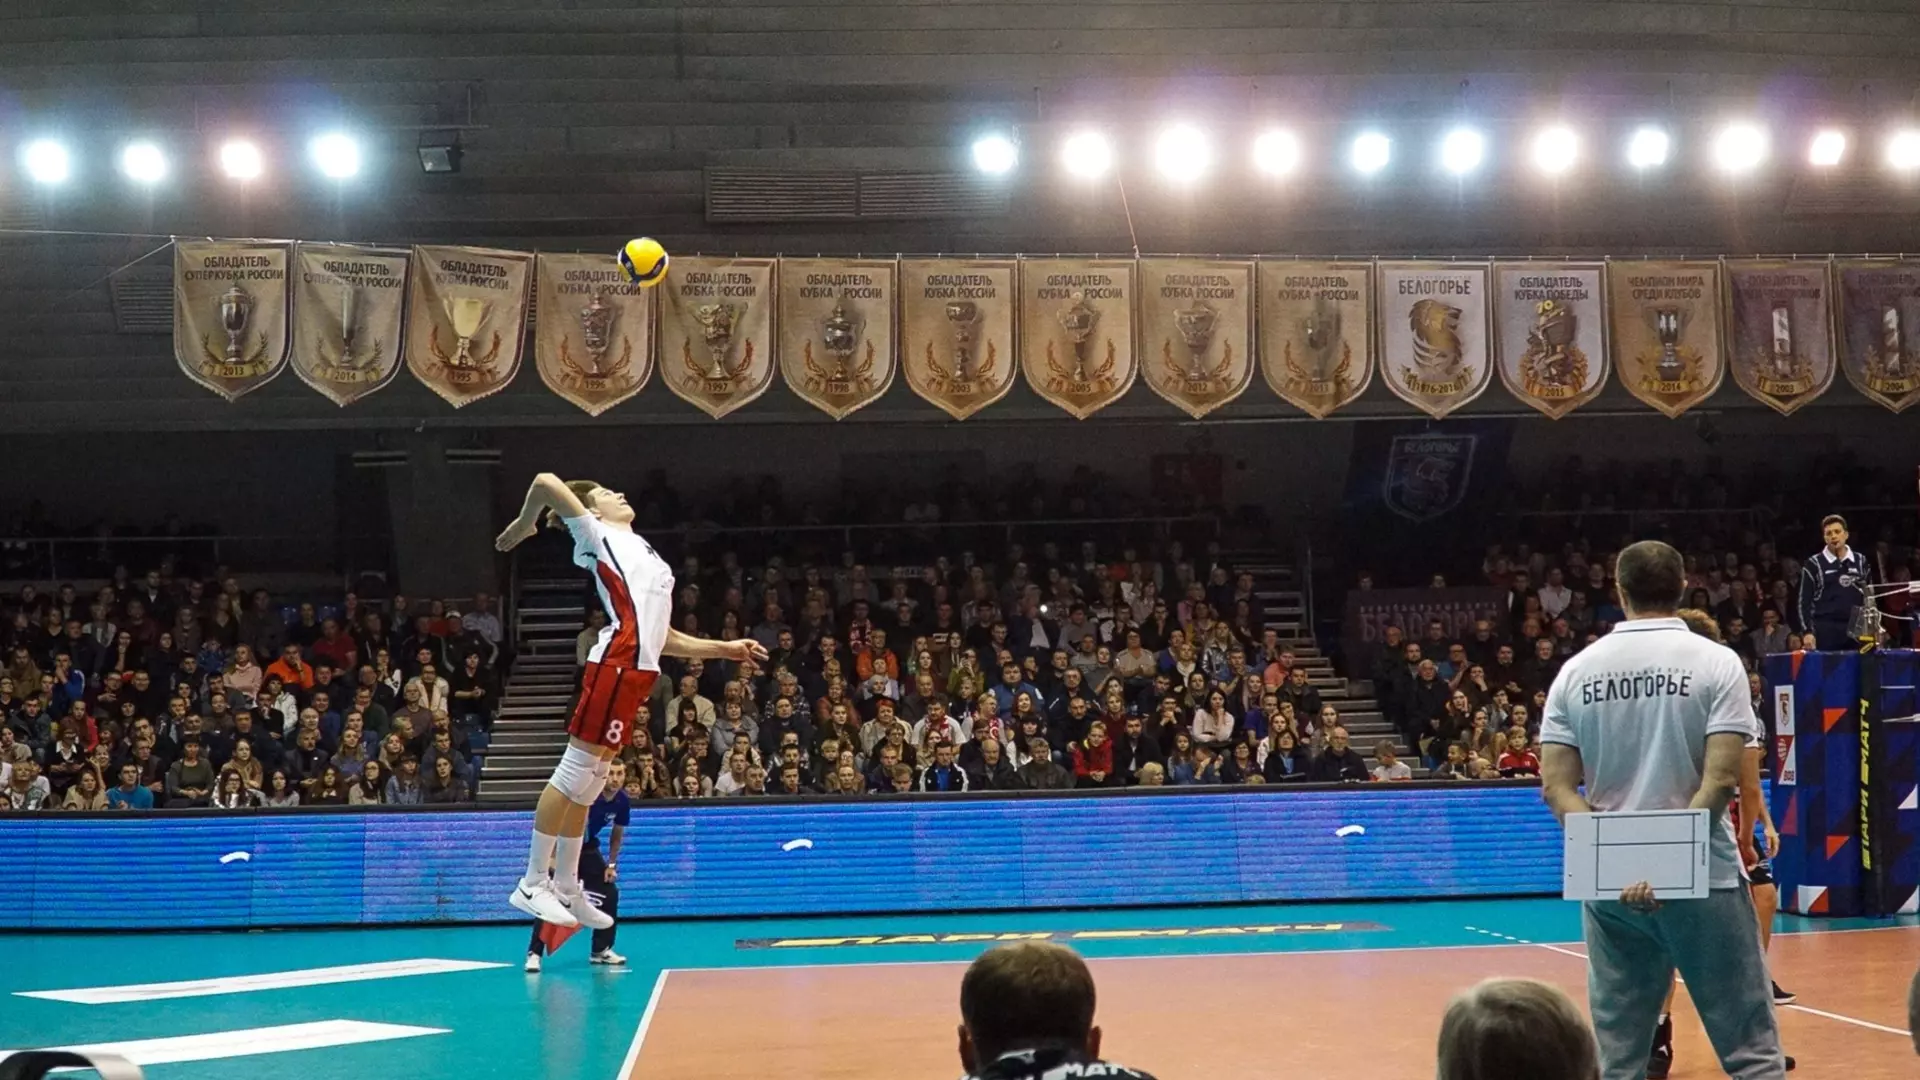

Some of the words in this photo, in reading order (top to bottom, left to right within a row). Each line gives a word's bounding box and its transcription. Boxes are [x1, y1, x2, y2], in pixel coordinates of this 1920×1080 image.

[204, 256, 271, 268] ОБЛАДАТЕЛЬ
[324, 260, 390, 275] ОБЛАДАТЕЛЬ
[185, 269, 245, 281] СУПЕРКУБКА
[247, 268, 284, 280] РОССИИ
[441, 260, 507, 278] ОБЛАДАТЕЛЬ
[366, 276, 401, 288] РОССИИ
[435, 272, 468, 285] КУБКА
[470, 275, 509, 290] РОССИИ
[564, 270, 625, 283] ОБЛАДАТЕЛ
[686, 272, 751, 285] ОБЛАДАТЕЛЬ
[806, 274, 872, 287] ОБЛАДАТЕЛЬ
[927, 274, 992, 287] ОБЛАДАТЕЛЬ
[1047, 274, 1111, 287] ОБЛАДАТЕЛЬ
[1165, 275, 1230, 287] ОБЛАДАТЕЛЬ
[1284, 276, 1348, 288] ОБЛАДАТЕЛЬ
[1627, 276, 1675, 287] ЧЕМПИОН
[1677, 276, 1704, 286] МИРА
[1399, 280, 1471, 295] БЕЛОГОРЬЕ
[1519, 277, 1583, 289] ОБЛАДАТЕЛЬ
[558, 283, 591, 294] КУБКА
[602, 284, 640, 296] РОССИИ
[681, 286, 714, 297] КУБКА
[718, 286, 756, 297] РОССИИ
[800, 287, 833, 298] КУБКА
[844, 287, 882, 299] РОССИИ
[925, 288, 955, 299] КУБКА
[958, 288, 995, 299] РОССИИ
[1037, 288, 1070, 299] КУБКА
[1084, 288, 1123, 299] РОССИИ
[1160, 287, 1194, 299] КУБКА
[1197, 288, 1234, 299] РОССИИ
[1278, 289, 1310, 301] КУБКА
[1321, 290, 1359, 301] РОССИИ
[1514, 289, 1545, 300] КУБКА
[1546, 289, 1588, 301] ПОБЕДЫ
[1632, 288, 1663, 300] СРЕДИ
[1665, 289, 1702, 299] КЛУБОВ
[223, 365, 244, 376] 2013
[335, 371, 356, 381] 2014
[452, 371, 472, 382] 1995
[585, 380, 605, 390] 1996
[708, 382, 727, 392] 1997
[1661, 382, 1681, 391] 2014
[1583, 674, 1692, 705] БЕЛОГОРЬЕ
[606, 719, 624, 744] 8
